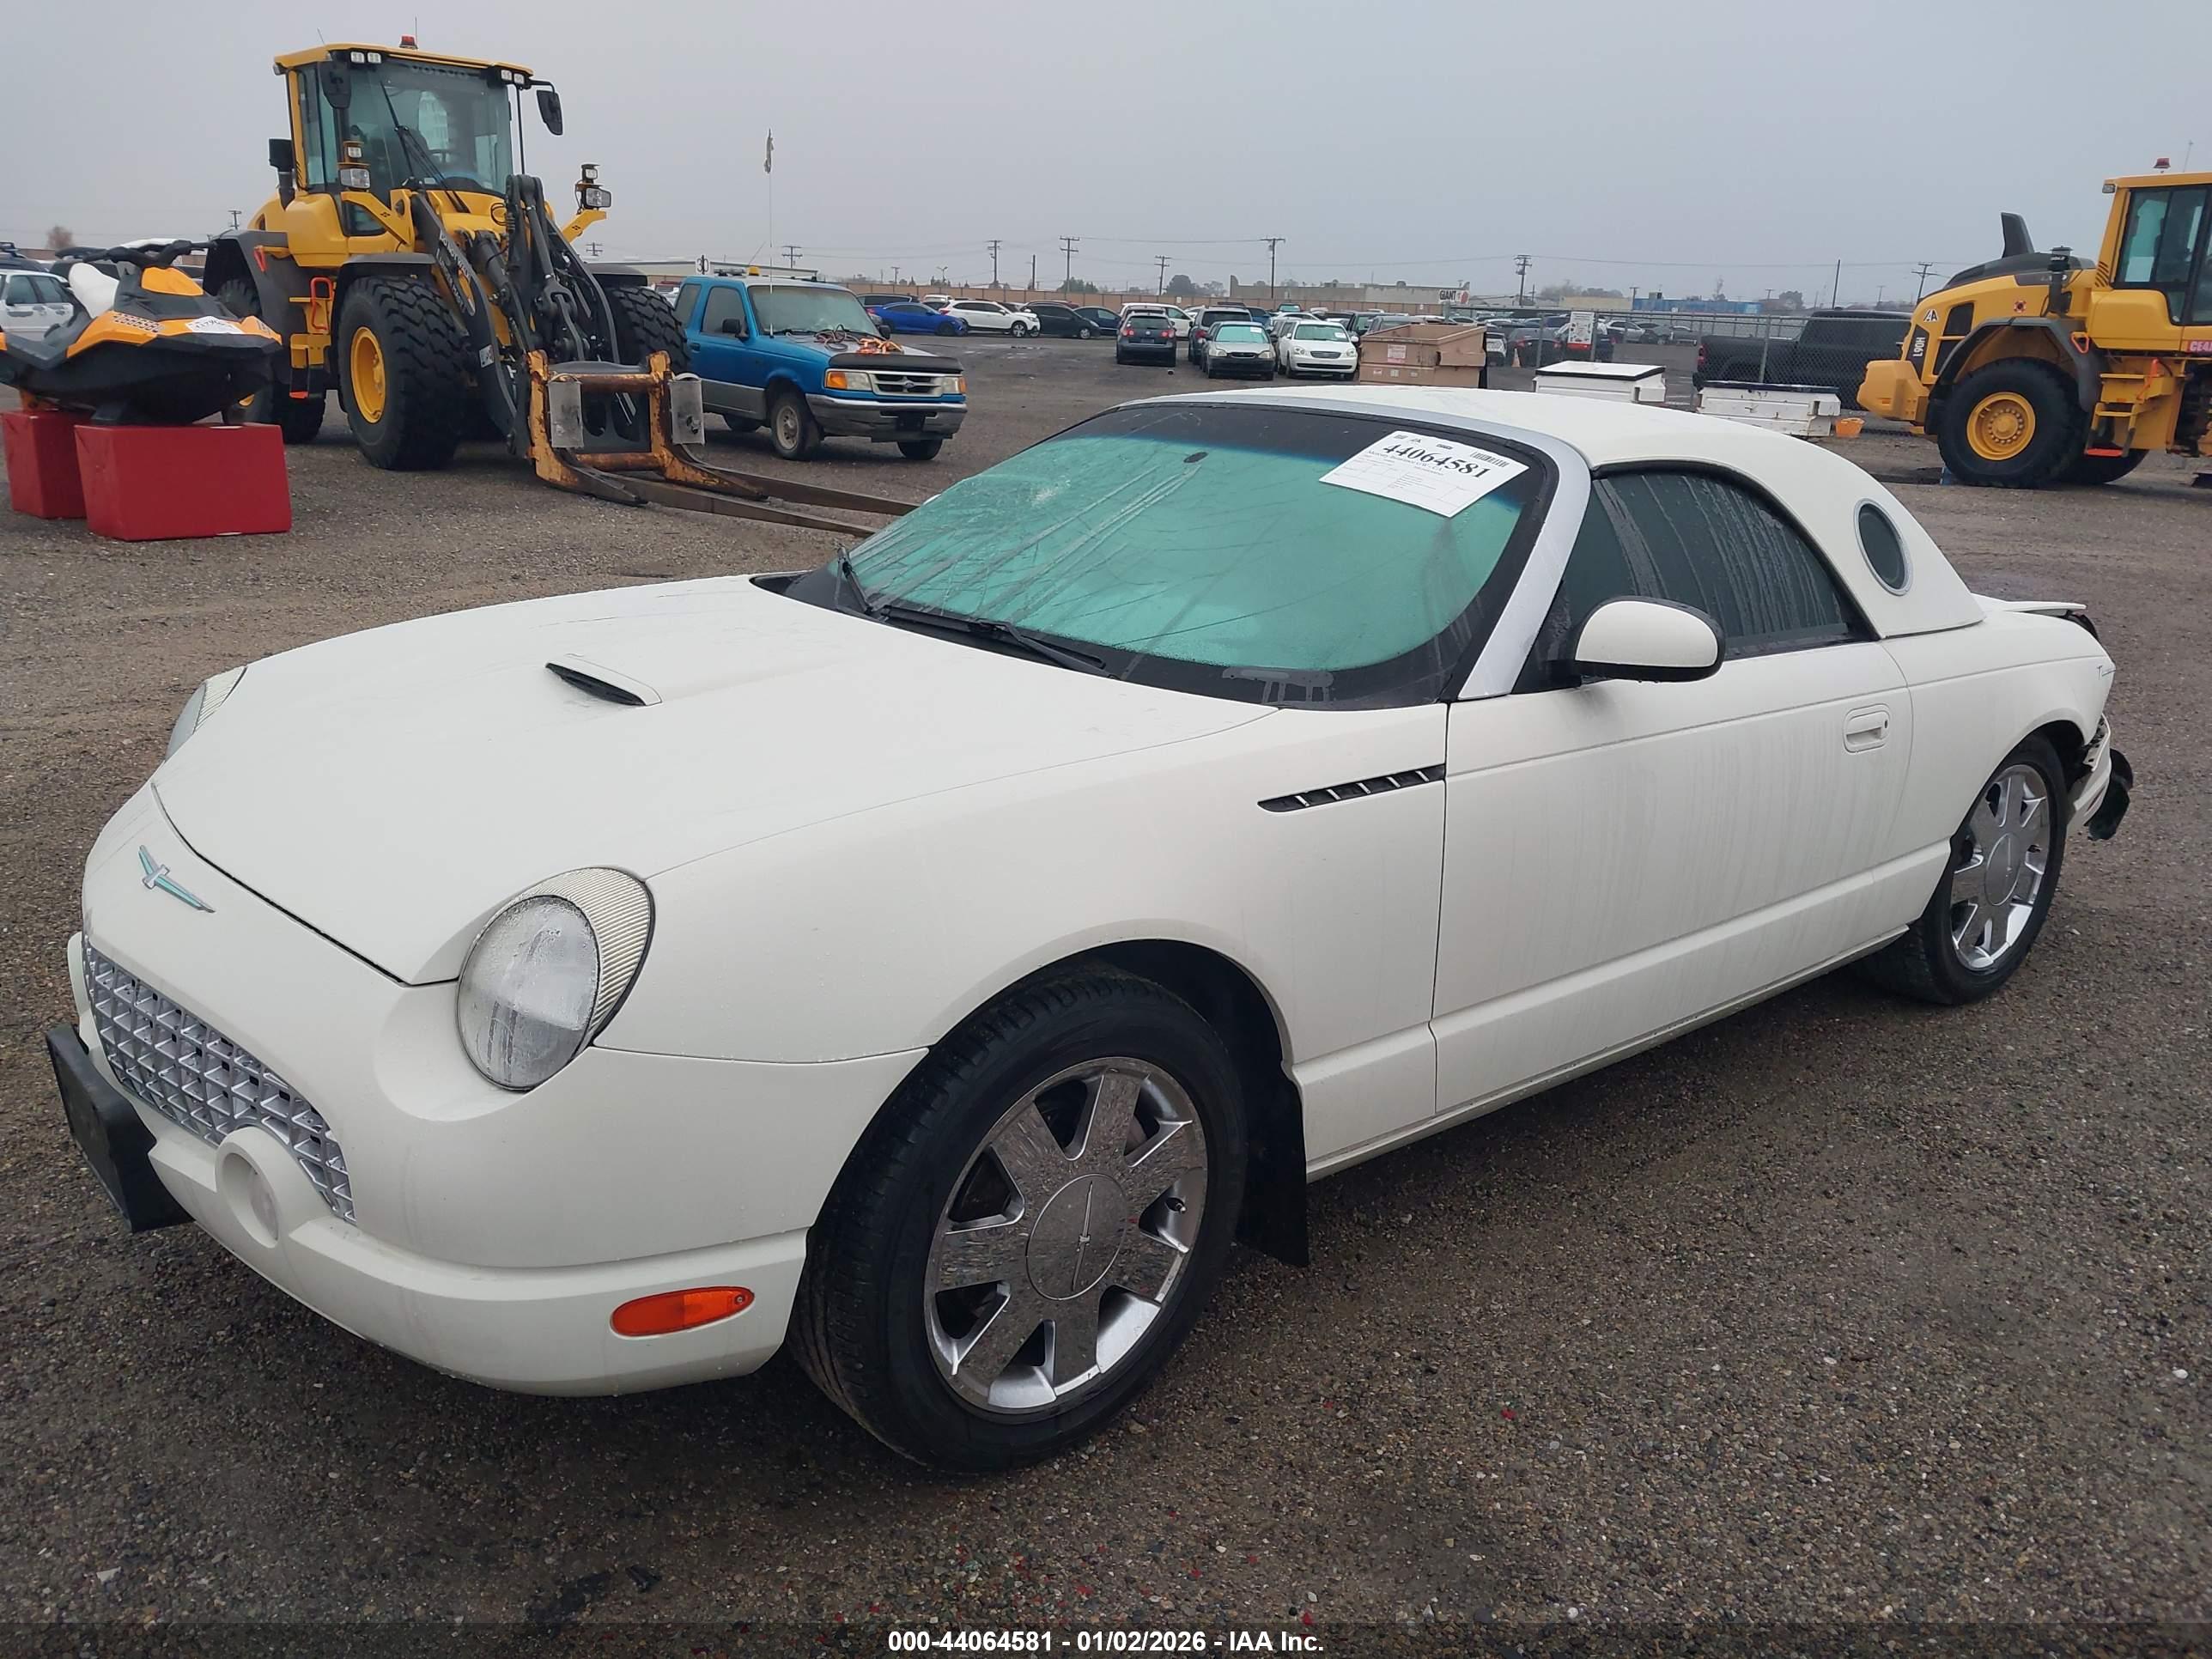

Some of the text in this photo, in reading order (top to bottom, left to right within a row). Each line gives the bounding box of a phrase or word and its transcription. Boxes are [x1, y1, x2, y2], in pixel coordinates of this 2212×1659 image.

[1439, 289, 1457, 301] GIANT
[1912, 337, 1927, 357] L90H
[1382, 444, 1492, 478] 44064581
